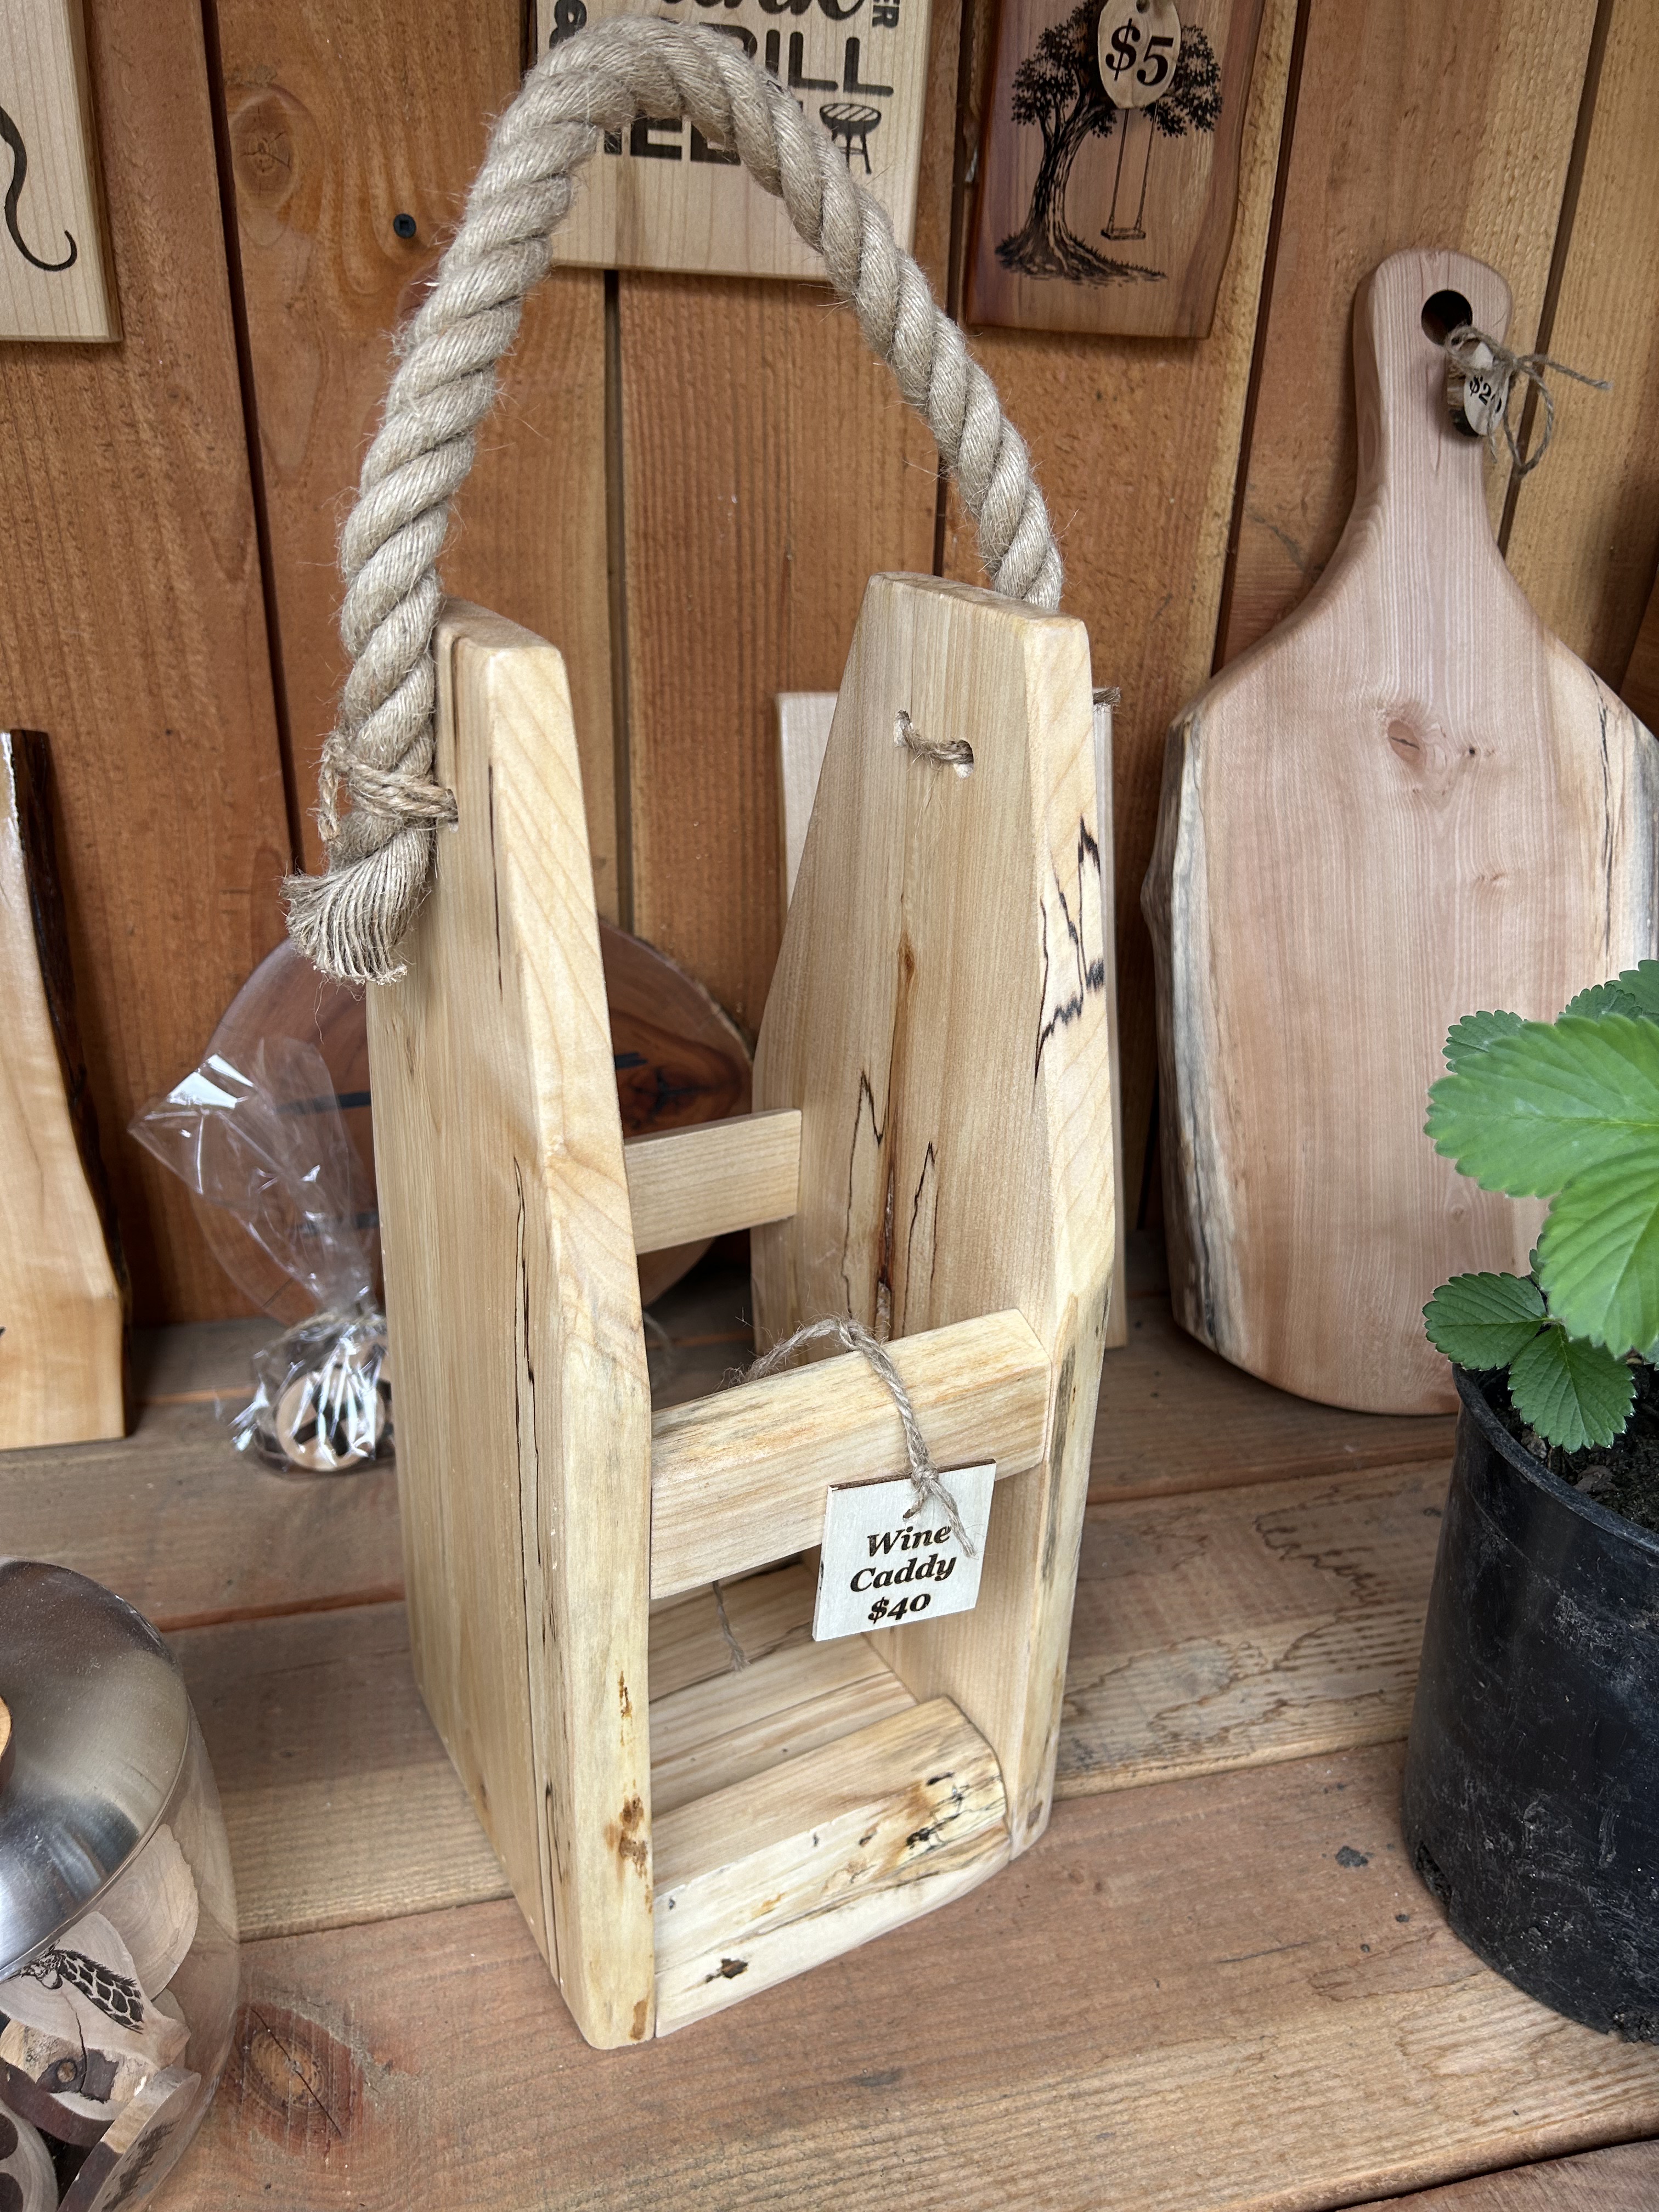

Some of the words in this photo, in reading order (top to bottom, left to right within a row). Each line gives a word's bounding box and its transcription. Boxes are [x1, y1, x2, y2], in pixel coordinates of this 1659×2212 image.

[659, 15, 895, 98] ILL
[1105, 18, 1174, 87] $5
[867, 1525, 951, 1558] Wine
[850, 1554, 957, 1592] Caddy
[867, 1593, 931, 1624] $40
